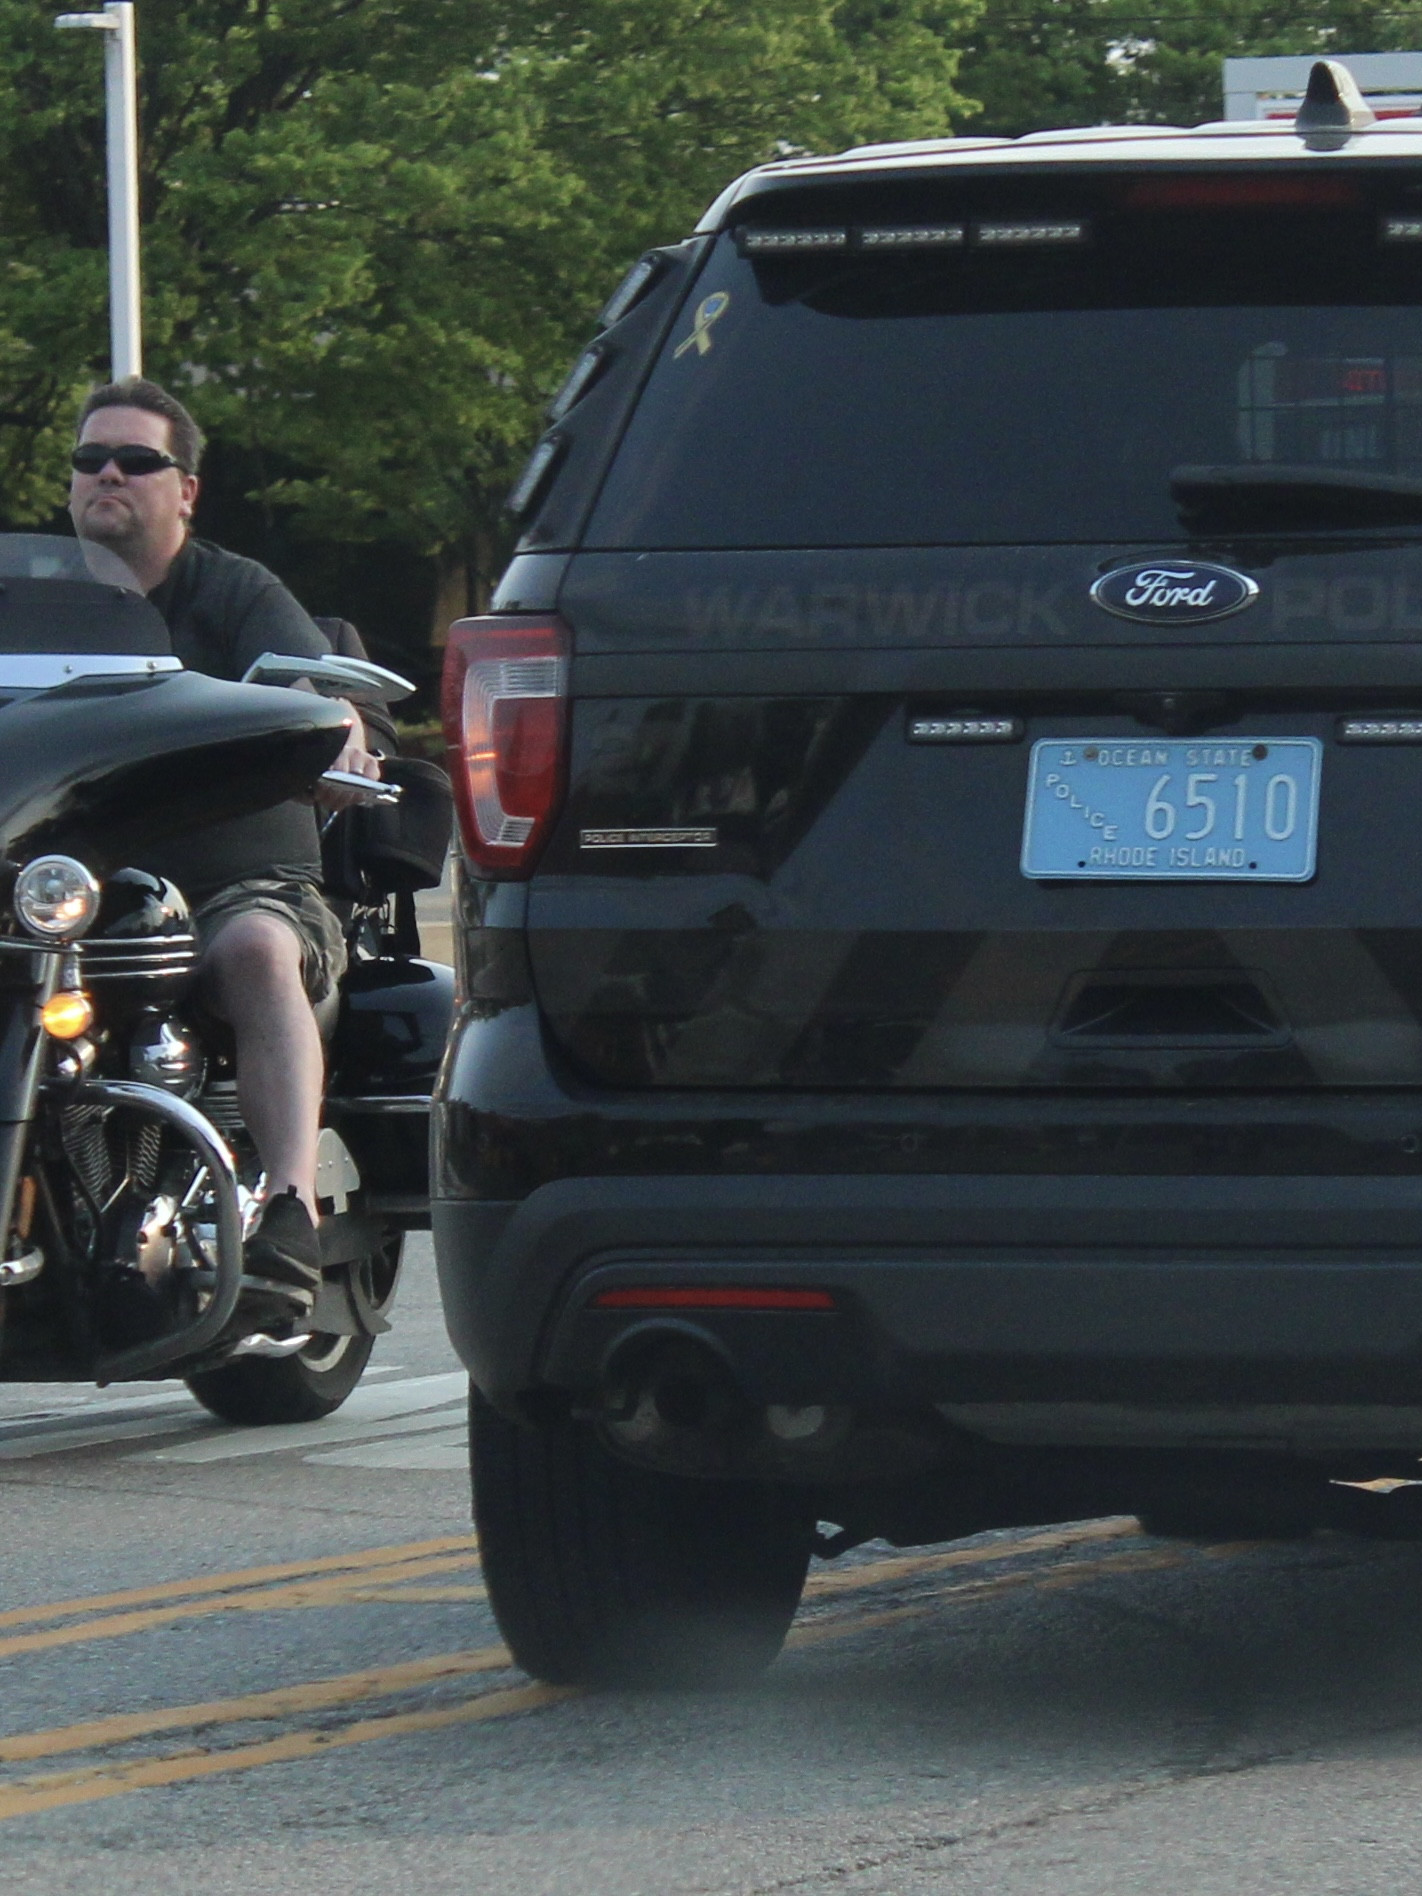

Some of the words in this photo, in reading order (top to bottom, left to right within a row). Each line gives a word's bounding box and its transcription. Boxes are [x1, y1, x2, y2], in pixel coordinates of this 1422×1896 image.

[686, 581, 1070, 638] WARWICK
[1125, 568, 1218, 607] Ford
[1098, 748, 1169, 767] OCEAN
[1186, 748, 1252, 767] STATE
[1045, 773, 1119, 841] POLICE
[1144, 772, 1297, 841] 6510
[1089, 846, 1159, 868] RHODE
[1169, 846, 1247, 868] ISLAND
